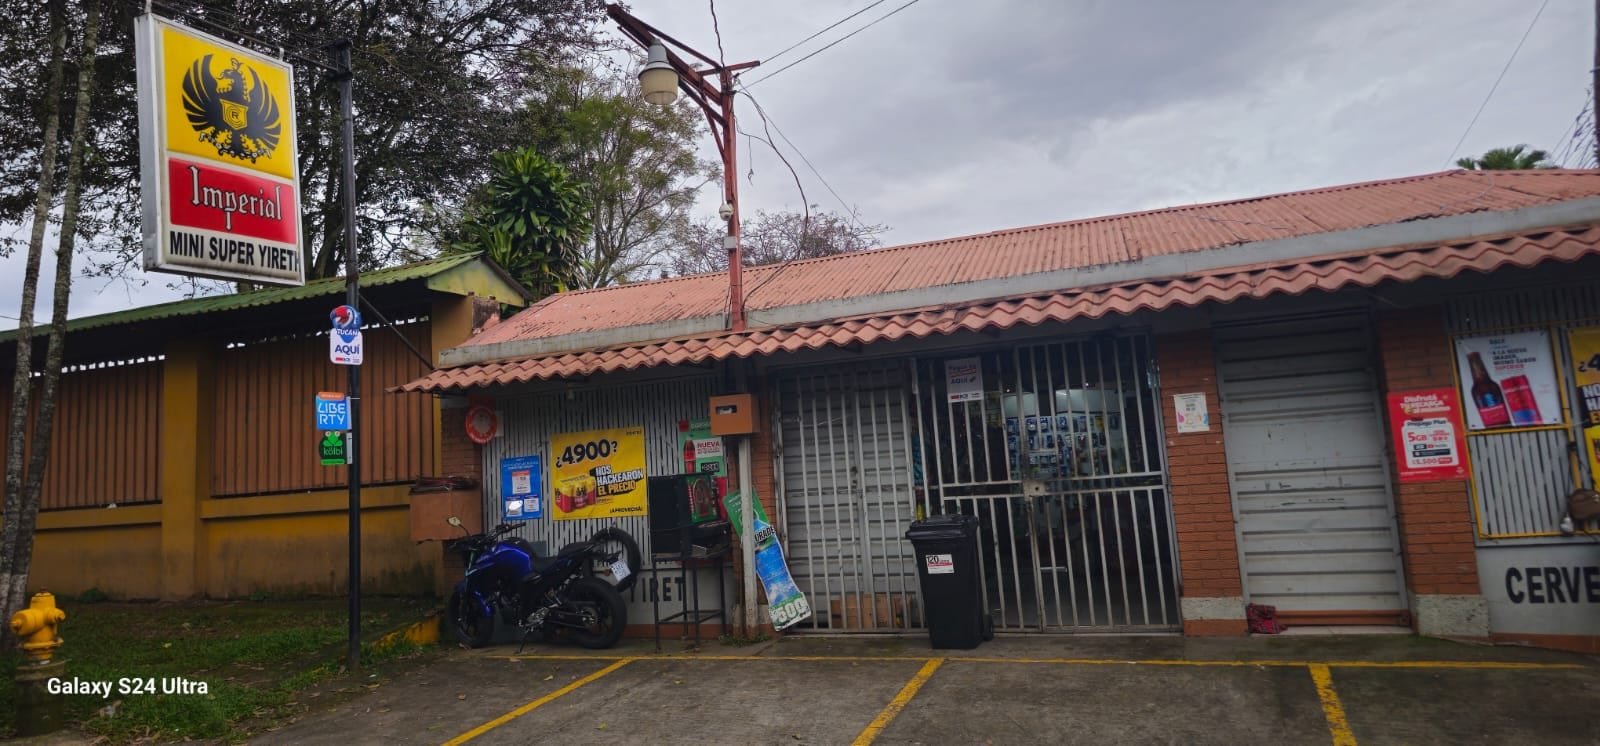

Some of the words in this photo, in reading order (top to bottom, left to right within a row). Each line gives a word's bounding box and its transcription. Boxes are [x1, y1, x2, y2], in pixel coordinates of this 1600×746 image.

[188, 165, 282, 231] Imperial
[170, 231, 204, 258] MINI
[209, 236, 255, 265] SUPER
[258, 244, 301, 272] YIRETH
[335, 344, 360, 355] AQUÍ
[318, 402, 346, 414] LIBE
[319, 413, 345, 425] RTY
[595, 465, 612, 476] NOS
[597, 469, 643, 487] HACKEARON
[598, 485, 607, 495] EL
[608, 481, 637, 494] PRECIO
[1505, 566, 1600, 604] CERVE
